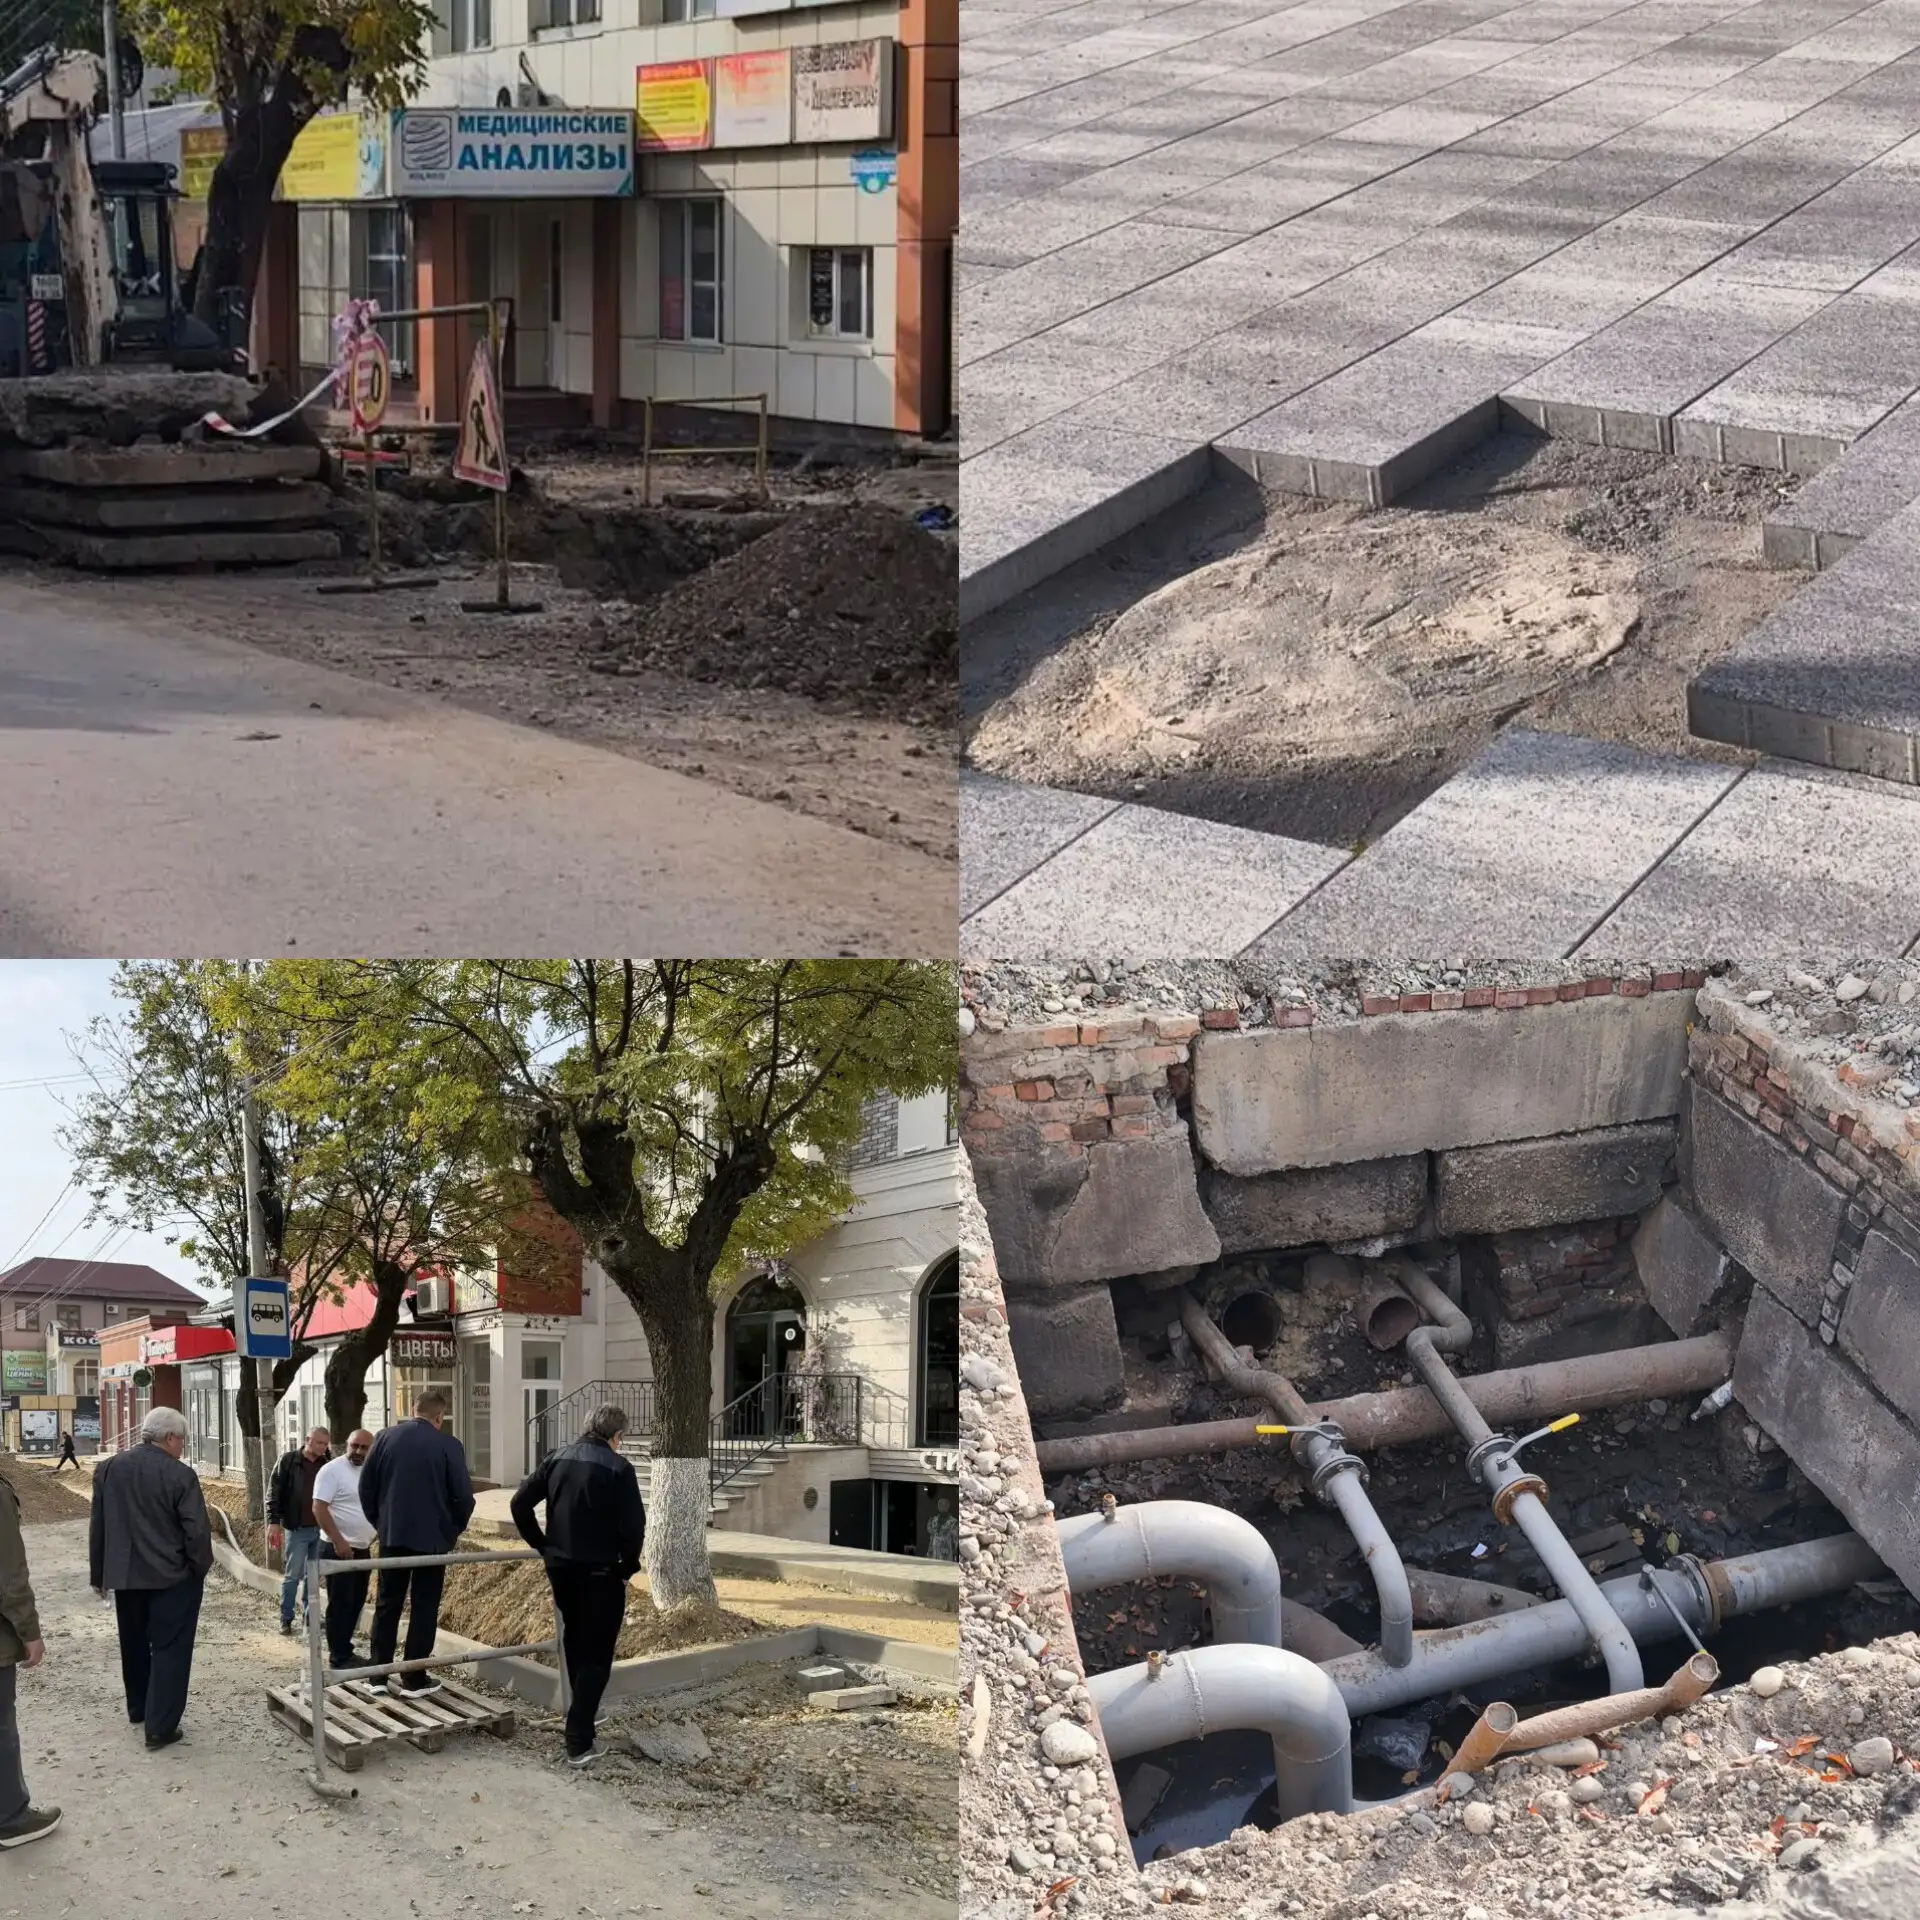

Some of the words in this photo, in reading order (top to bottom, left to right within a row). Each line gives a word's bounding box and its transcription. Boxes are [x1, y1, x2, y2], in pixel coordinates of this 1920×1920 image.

[457, 115, 628, 137] МЕДИЦИНСКИЕ
[457, 144, 627, 170] АНАЛИЗЫ
[400, 1340, 454, 1360] ЦВЕТЫ
